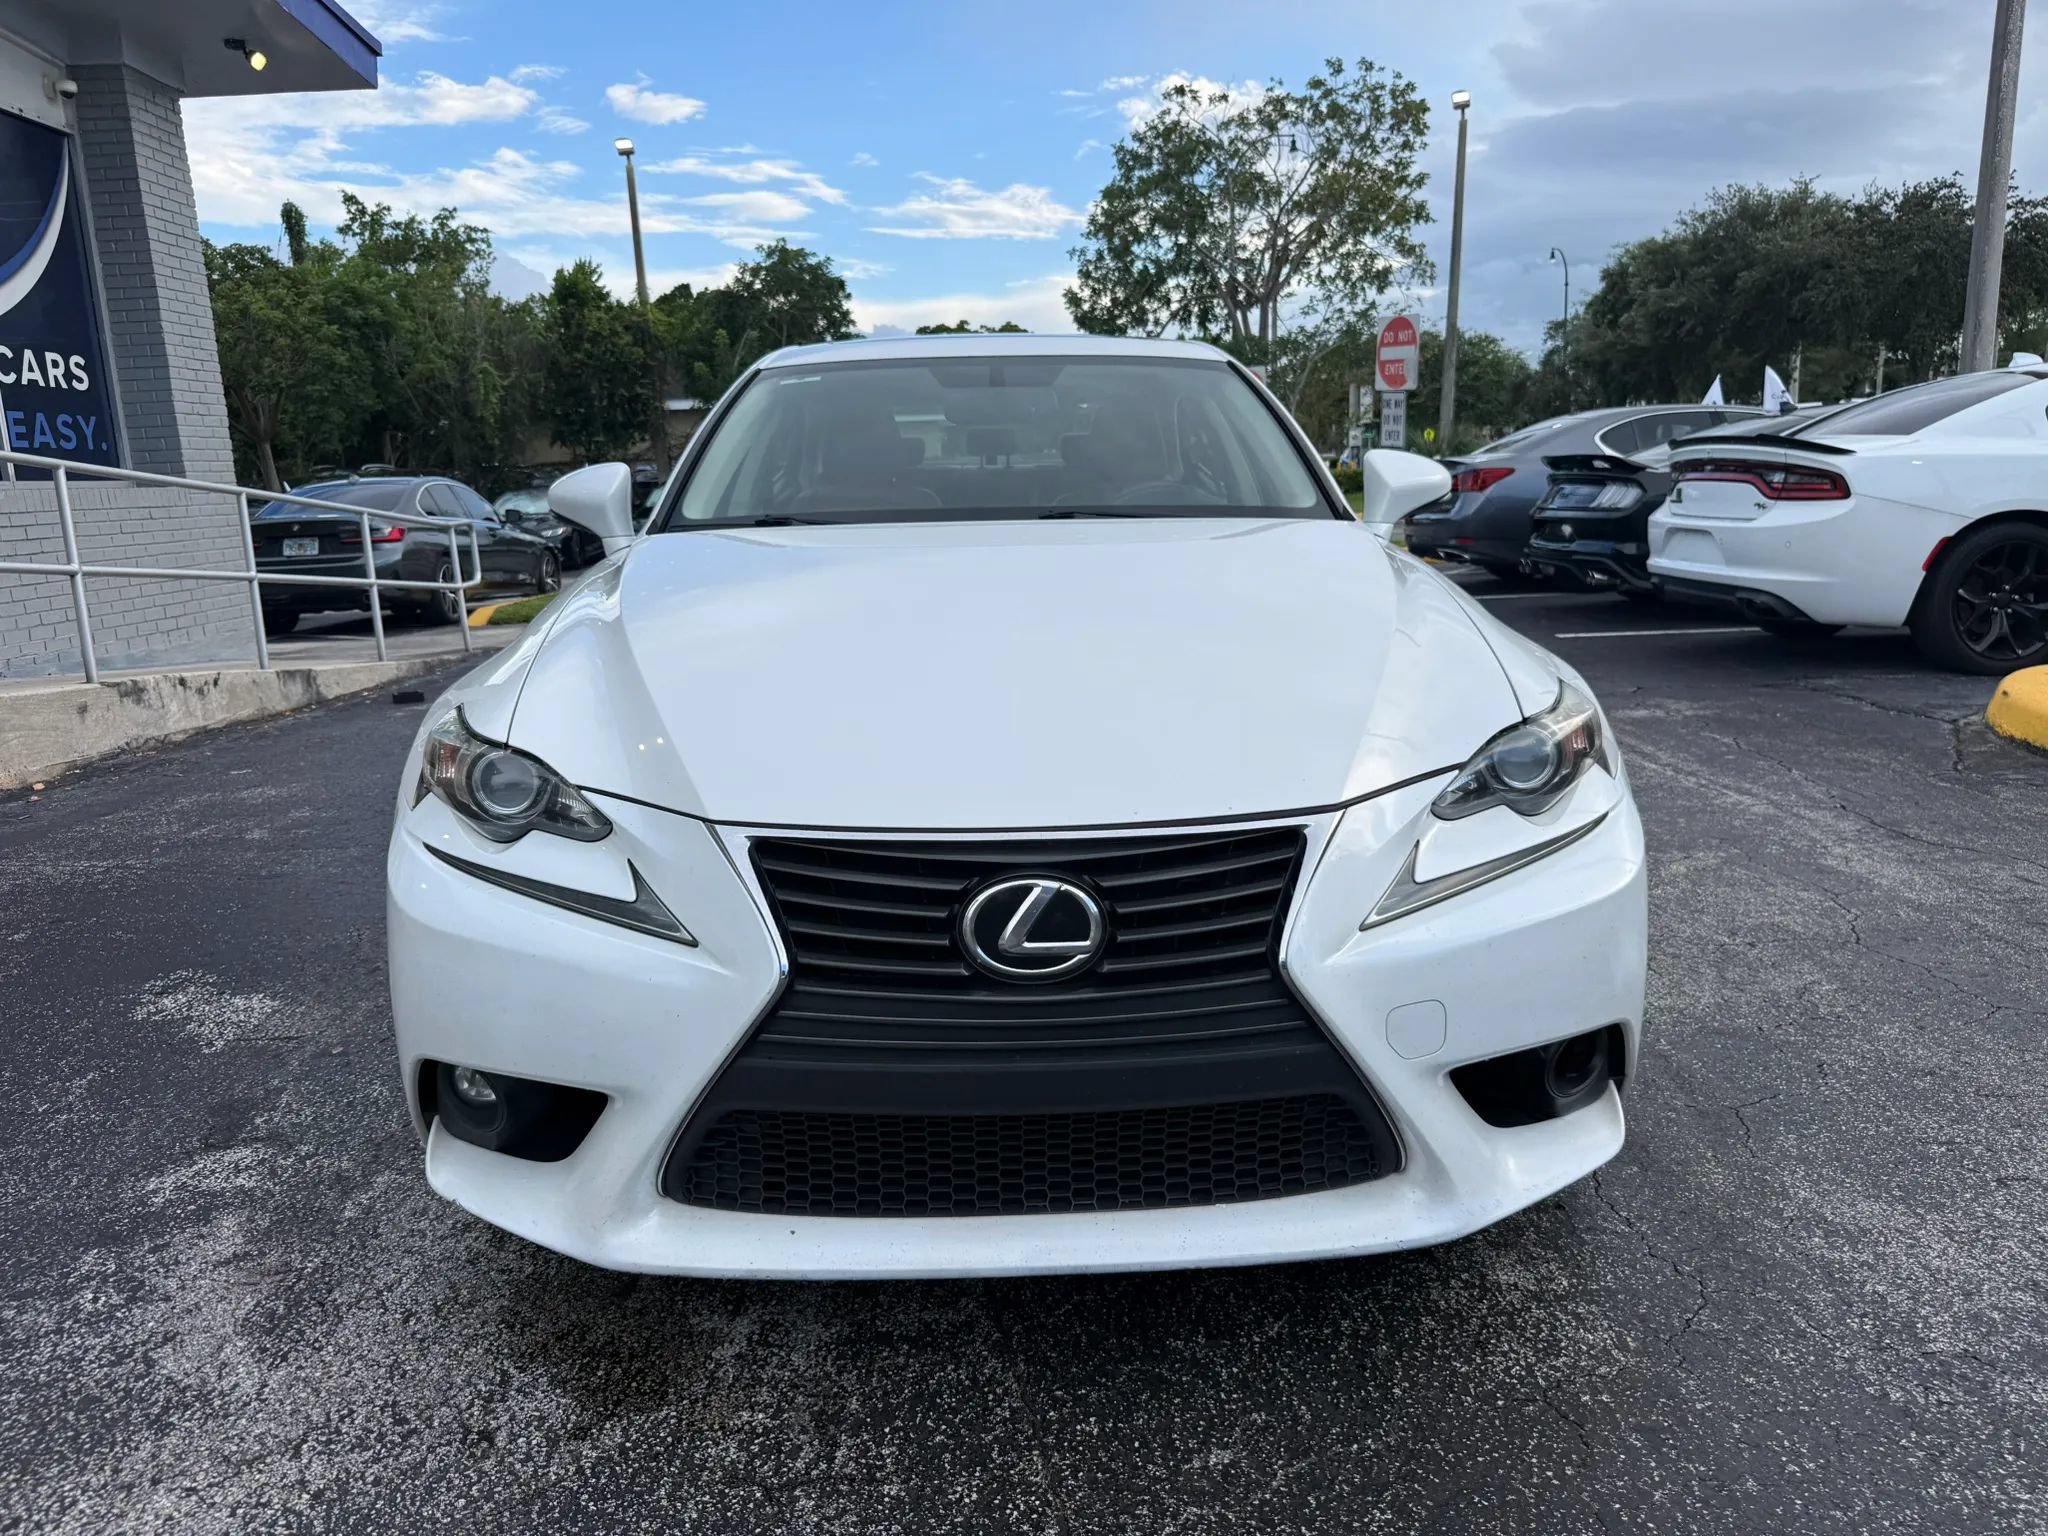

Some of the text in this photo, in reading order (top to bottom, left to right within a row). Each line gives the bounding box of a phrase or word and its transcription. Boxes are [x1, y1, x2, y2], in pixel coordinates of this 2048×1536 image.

[1384, 330, 1413, 343] DO NOT
[0, 345, 90, 391] CARS
[6, 410, 108, 451] EASY.
